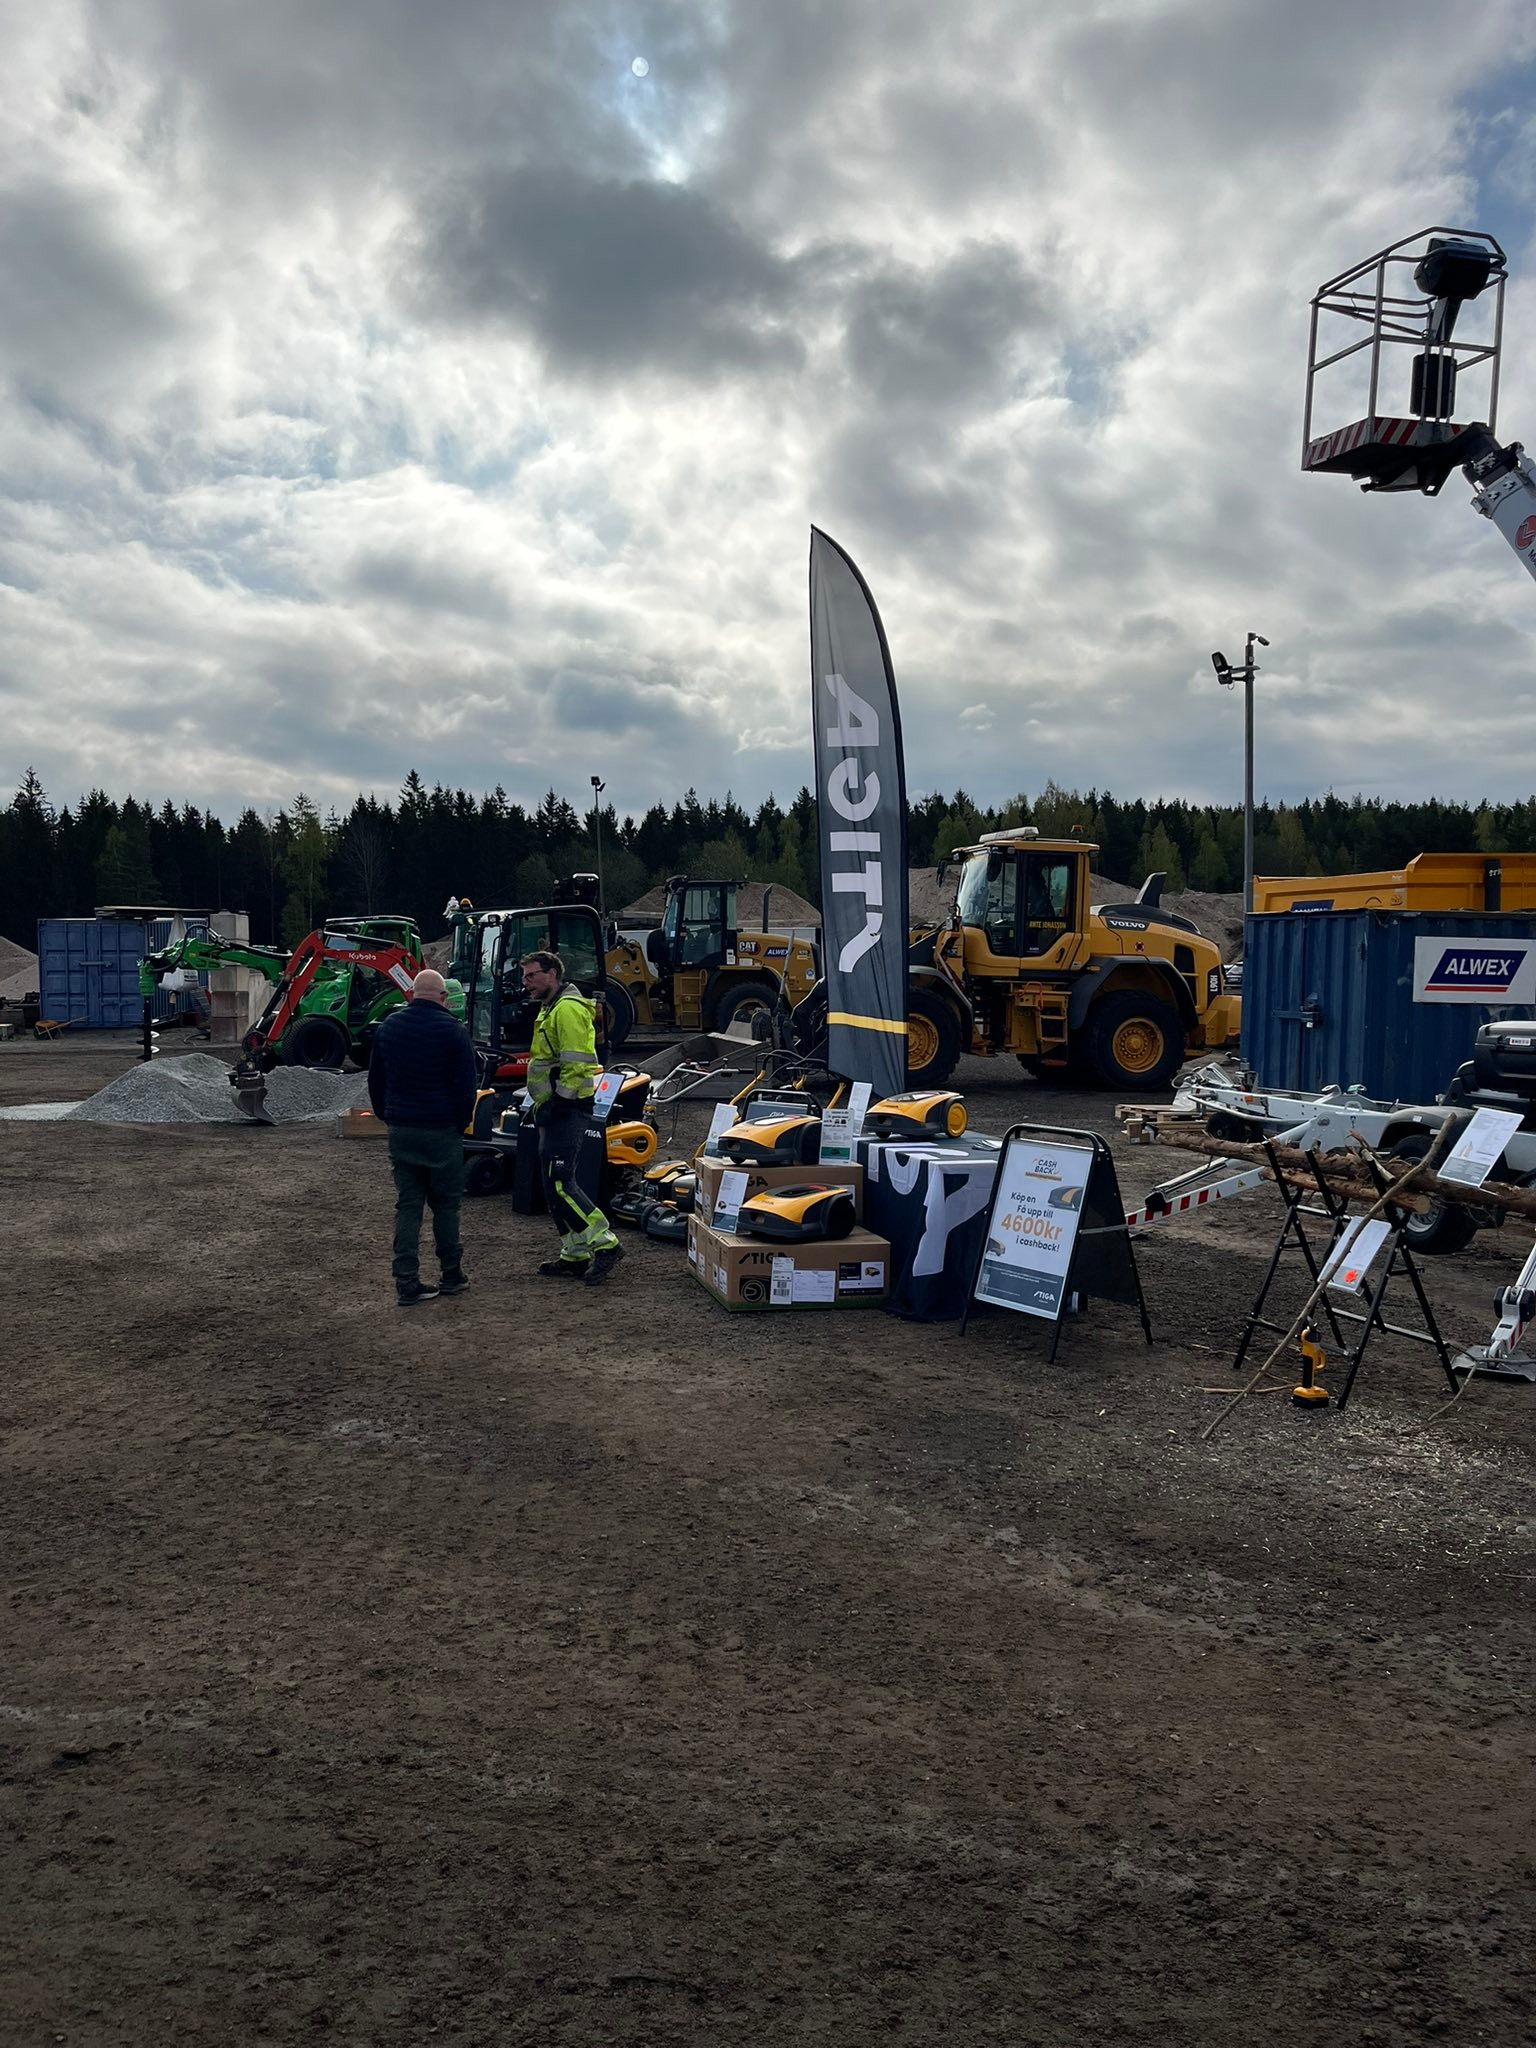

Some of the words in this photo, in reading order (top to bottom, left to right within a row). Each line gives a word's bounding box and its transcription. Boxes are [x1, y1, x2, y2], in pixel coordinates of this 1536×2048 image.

[1110, 919, 1146, 929] VOLVO
[738, 941, 757, 952] CAT
[348, 952, 377, 960] Kubota
[1444, 958, 1510, 976] ALWEX
[1034, 1165, 1055, 1175] BACK
[1037, 1159, 1058, 1169] CASH
[1010, 1191, 1026, 1203] Köp
[1017, 1204, 1027, 1213] Få
[1027, 1208, 1043, 1218] upp
[1043, 1209, 1054, 1218] till
[1001, 1213, 1063, 1240] 4600kr
[1020, 1238, 1060, 1252] cashback!
[1033, 1290, 1056, 1302] STIGA
